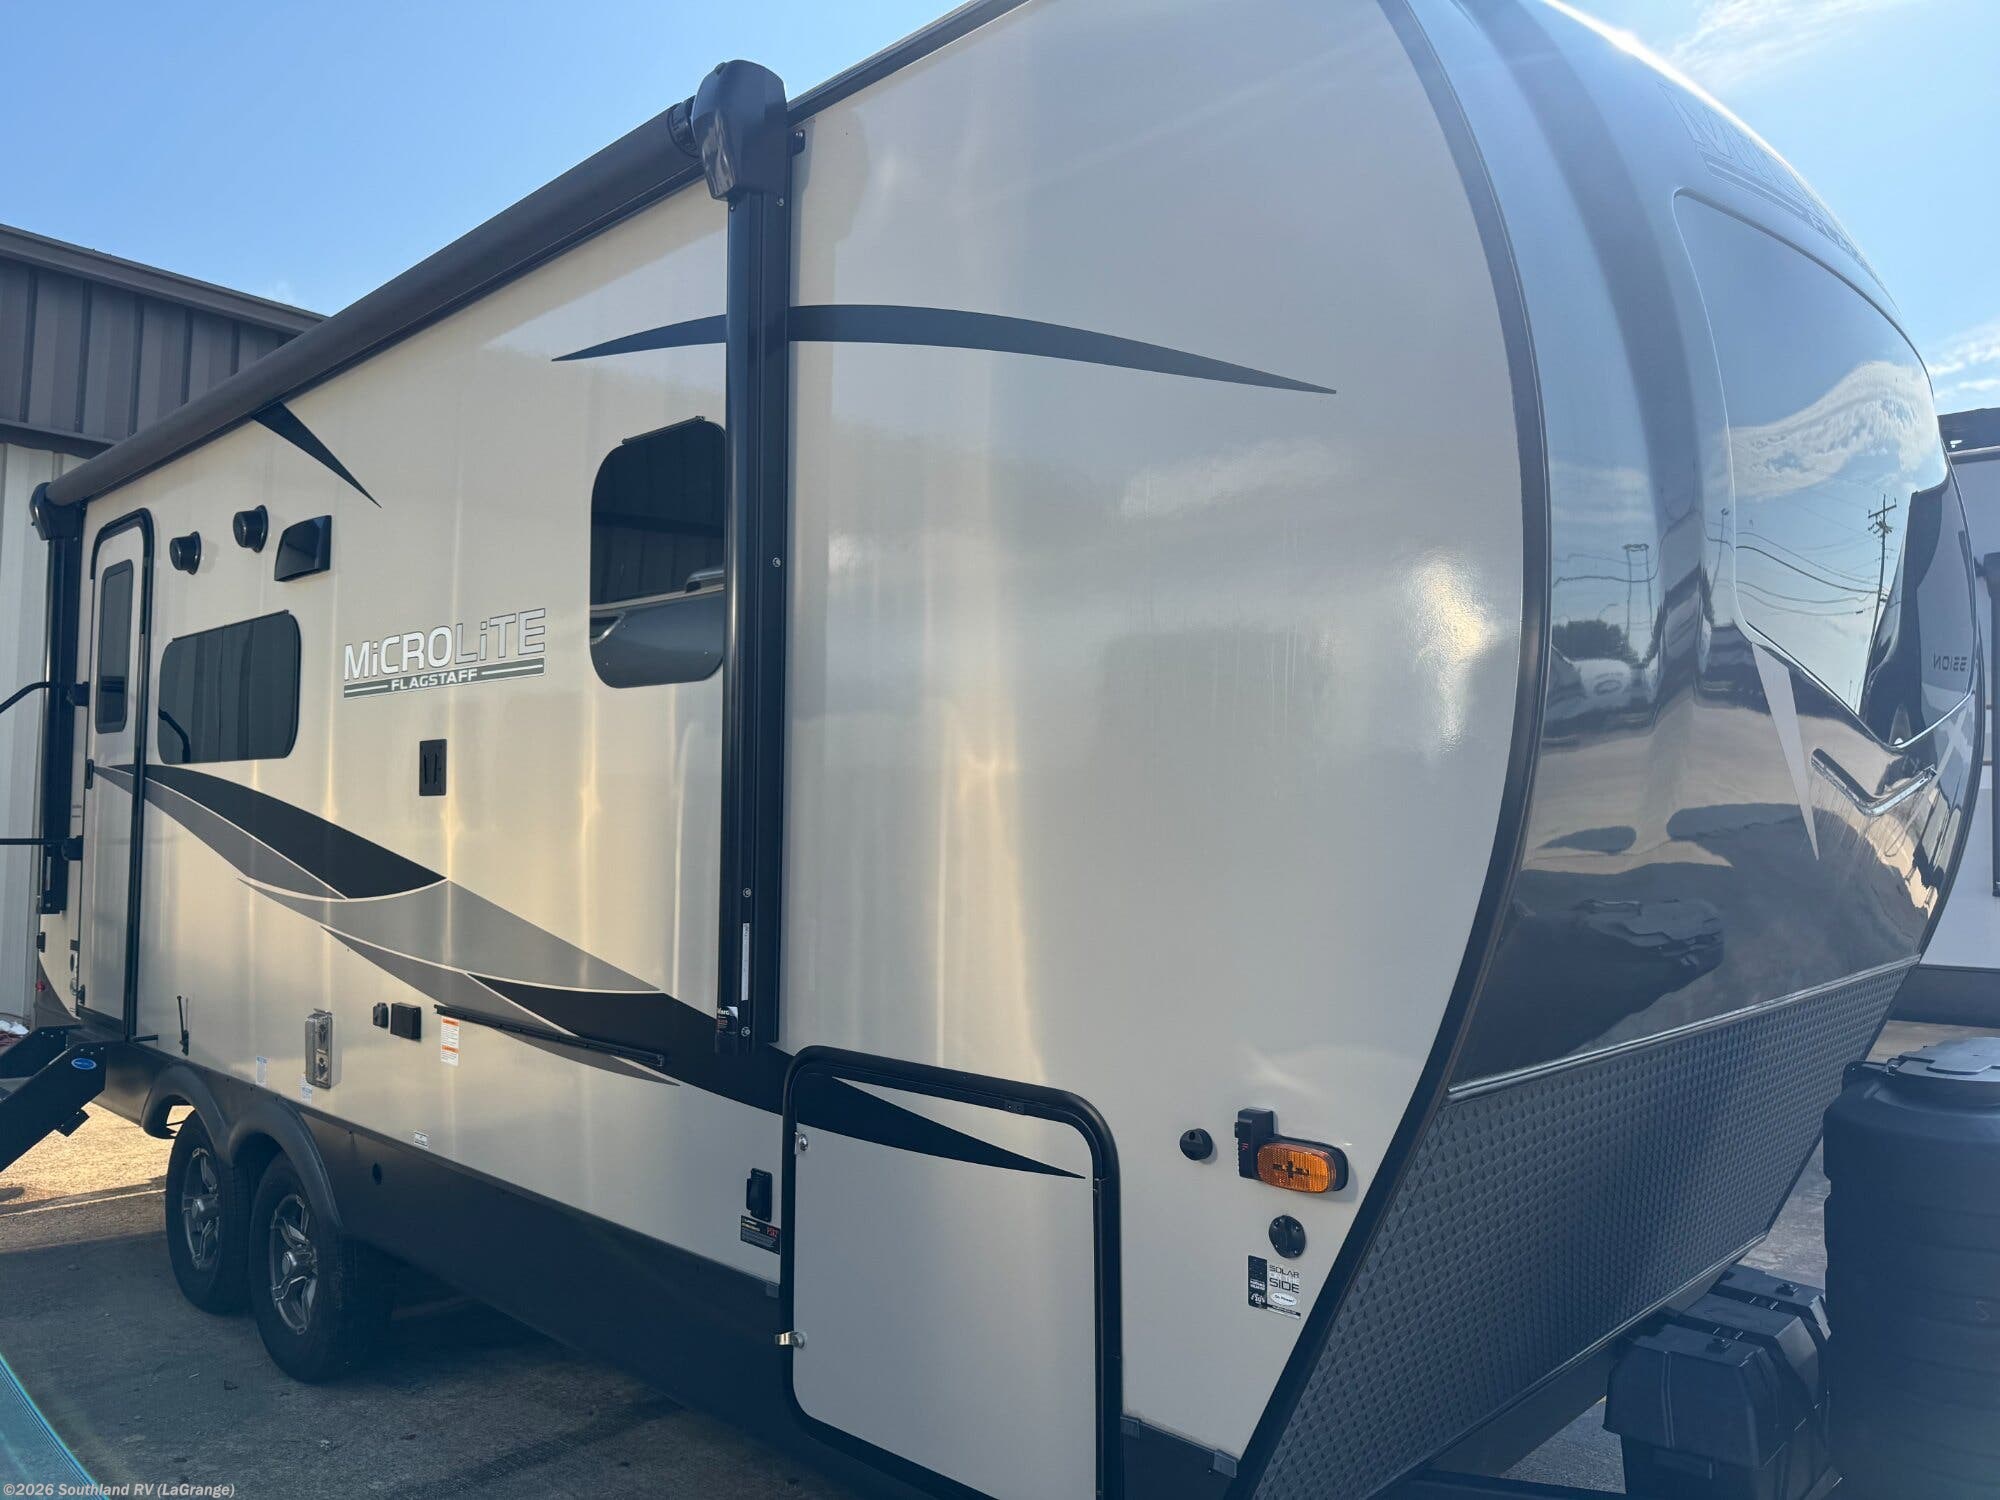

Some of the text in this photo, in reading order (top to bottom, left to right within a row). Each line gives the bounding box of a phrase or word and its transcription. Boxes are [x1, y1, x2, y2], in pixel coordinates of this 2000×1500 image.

[391, 668, 478, 691] FLAGSTAFF
[1269, 1264, 1300, 1278] SOLAR
[1269, 1277, 1300, 1294] SIDE
